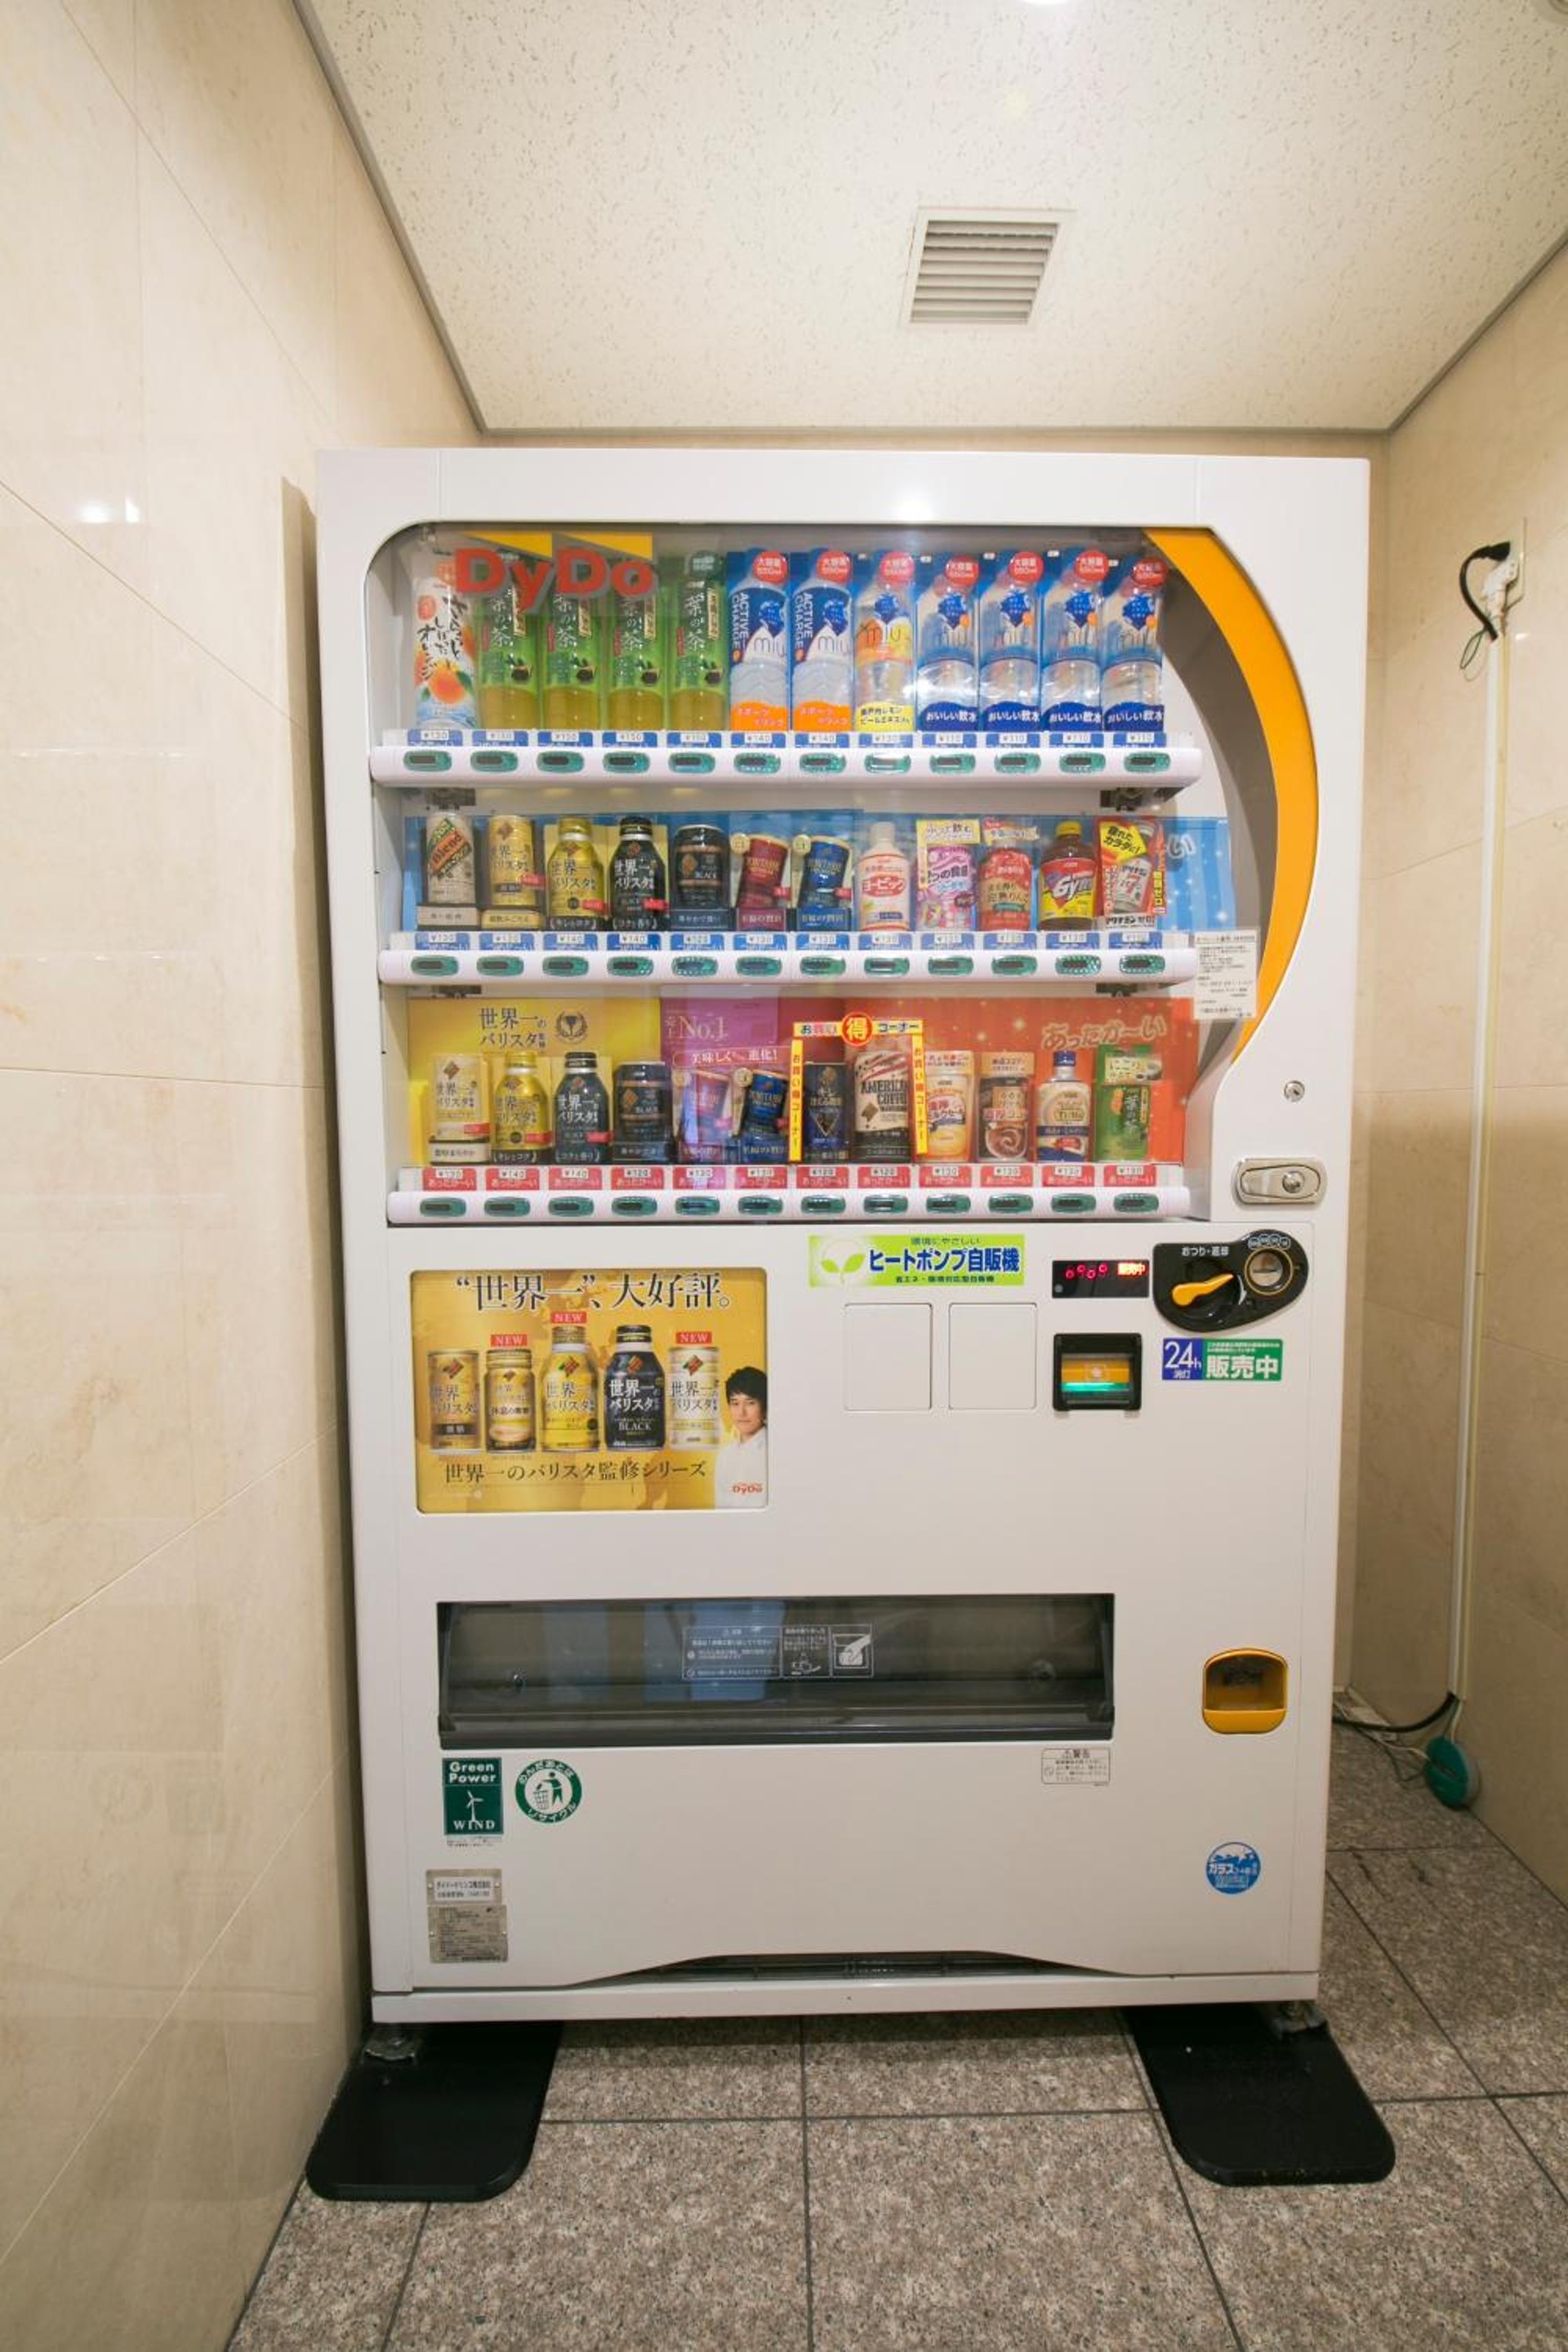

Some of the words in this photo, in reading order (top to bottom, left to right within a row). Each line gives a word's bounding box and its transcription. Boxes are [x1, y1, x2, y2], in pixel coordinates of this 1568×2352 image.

[454, 547, 656, 613] DyDo
[739, 593, 751, 644] ACTIVE
[803, 592, 813, 639] ACTIVE
[479, 1007, 546, 1031] 世界一の
[479, 1031, 538, 1049] バリスタ
[911, 1236, 980, 1246] 環境にやさしい
[1181, 1245, 1230, 1257] おつり・返却
[868, 1246, 1020, 1273] ヒートポンプ自販機
[554, 1313, 582, 1323] NEW
[494, 1335, 524, 1345] NEW
[679, 1334, 708, 1343] NEW
[1164, 1341, 1202, 1370] 24h
[1205, 1354, 1279, 1380] 販売中
[608, 1379, 655, 1397] 世界一
[609, 1398, 653, 1413] バリスタ
[618, 1421, 652, 1431] BLACK
[445, 1459, 706, 1484] 世界一のバリスタ監修シリーズ
[732, 1484, 763, 1494] DyDo
[449, 1762, 495, 1773] Green
[448, 1773, 497, 1784] Power
[527, 1802, 578, 1823] リサイクル
[452, 1820, 496, 1830] WIND
